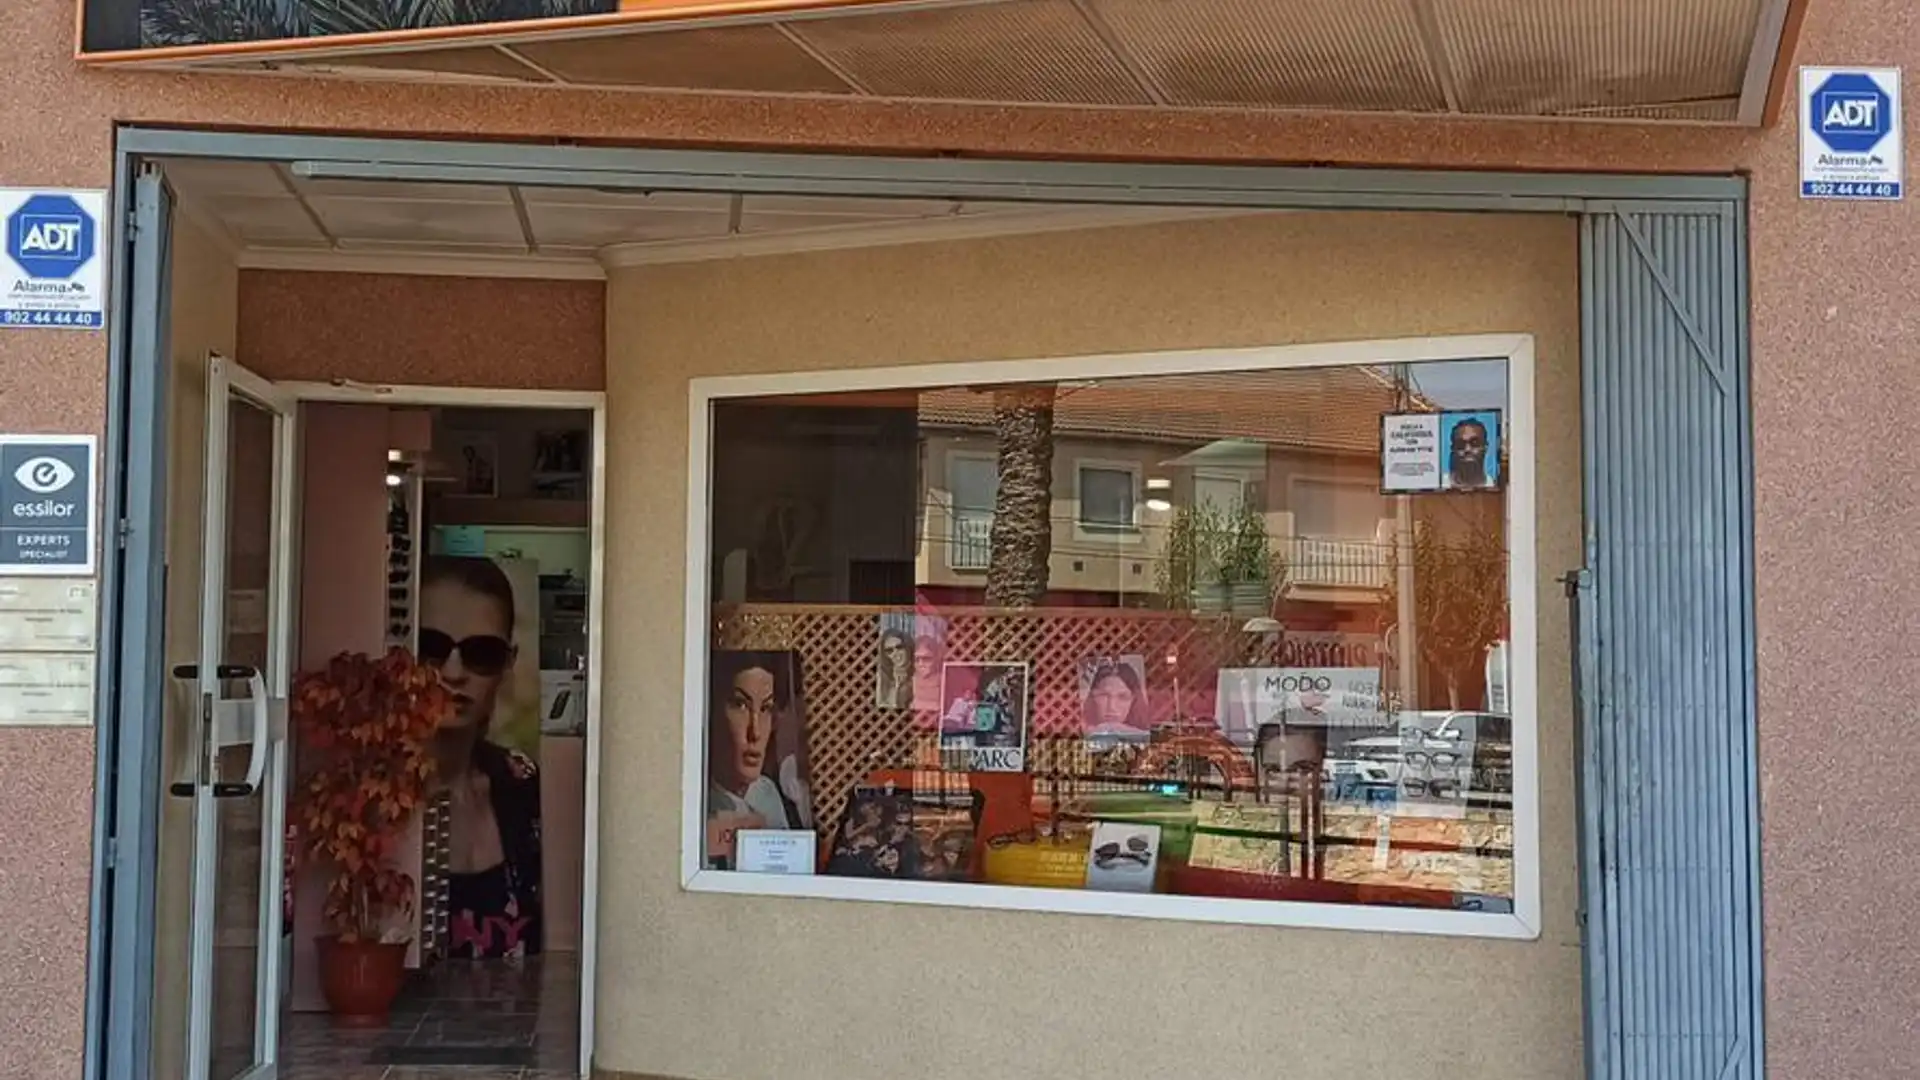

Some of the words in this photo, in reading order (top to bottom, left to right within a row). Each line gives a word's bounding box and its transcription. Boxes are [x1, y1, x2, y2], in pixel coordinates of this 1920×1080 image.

[1823, 99, 1878, 127] ADT
[1818, 153, 1867, 165] Alarma
[1811, 183, 1835, 195] 902
[1838, 183, 1853, 195] 44
[1856, 183, 1872, 195] 44
[1875, 183, 1891, 196] 40
[21, 222, 81, 252] ADT
[13, 279, 66, 293] Alarma
[4, 310, 30, 324] 902
[33, 311, 51, 324] 44
[54, 312, 72, 325] 44
[74, 312, 93, 326] 40
[12, 499, 76, 517] essilor
[17, 534, 71, 547] EXPERTS
[1264, 674, 1333, 693] MODO
